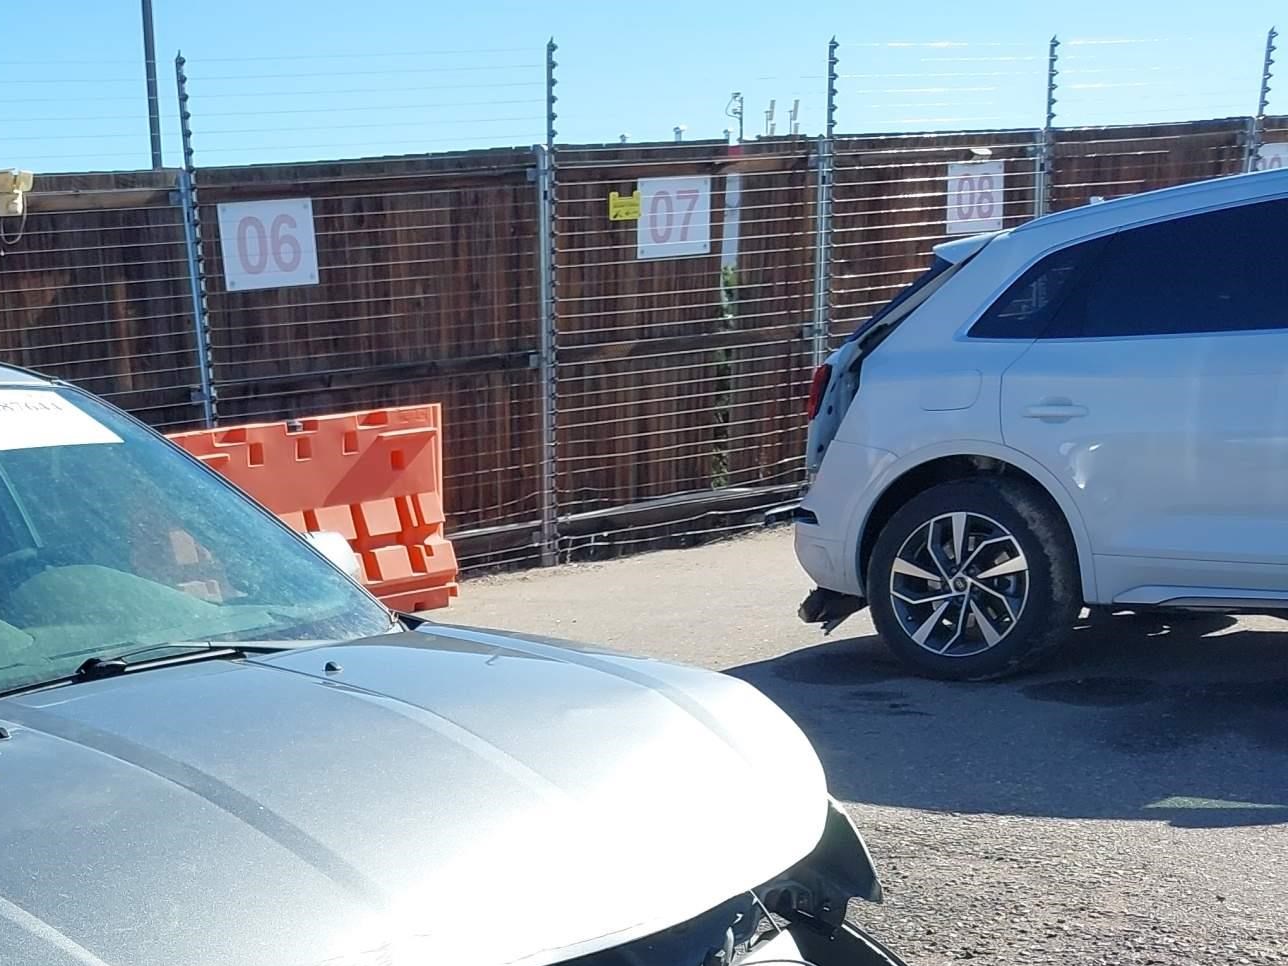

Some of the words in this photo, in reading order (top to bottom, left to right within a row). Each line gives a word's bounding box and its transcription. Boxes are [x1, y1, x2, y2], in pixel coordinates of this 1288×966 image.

[650, 190, 699, 243] 07
[957, 173, 994, 219] 08
[237, 214, 301, 274] 06
